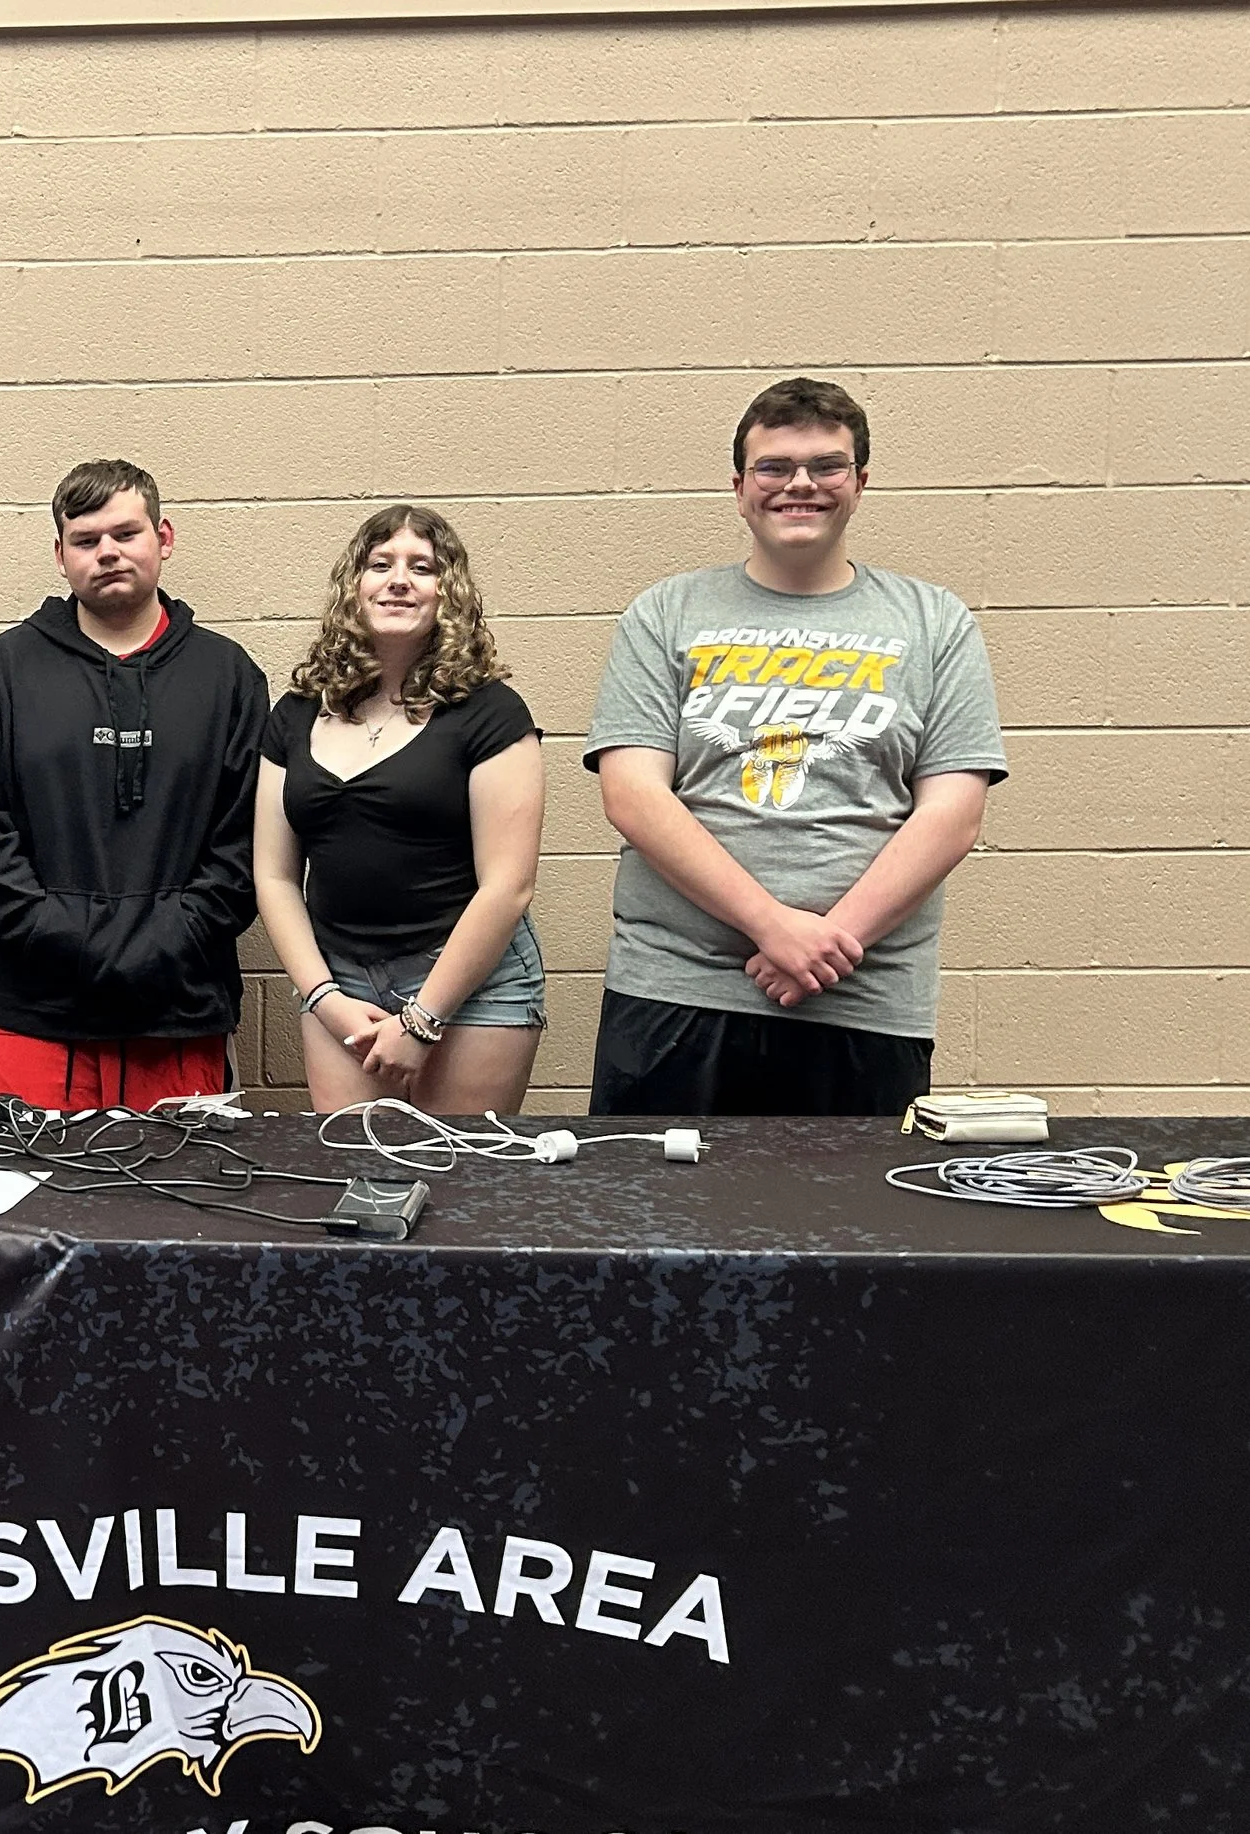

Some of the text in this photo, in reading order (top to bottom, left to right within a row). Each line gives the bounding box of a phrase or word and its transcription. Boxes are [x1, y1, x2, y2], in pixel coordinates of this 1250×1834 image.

[690, 627, 908, 657] BROWNSVILLE
[688, 645, 900, 693] TRACK
[681, 685, 898, 738] & FIELD
[398, 1527, 729, 1664] AREA
[72, 1660, 152, 1762] B
